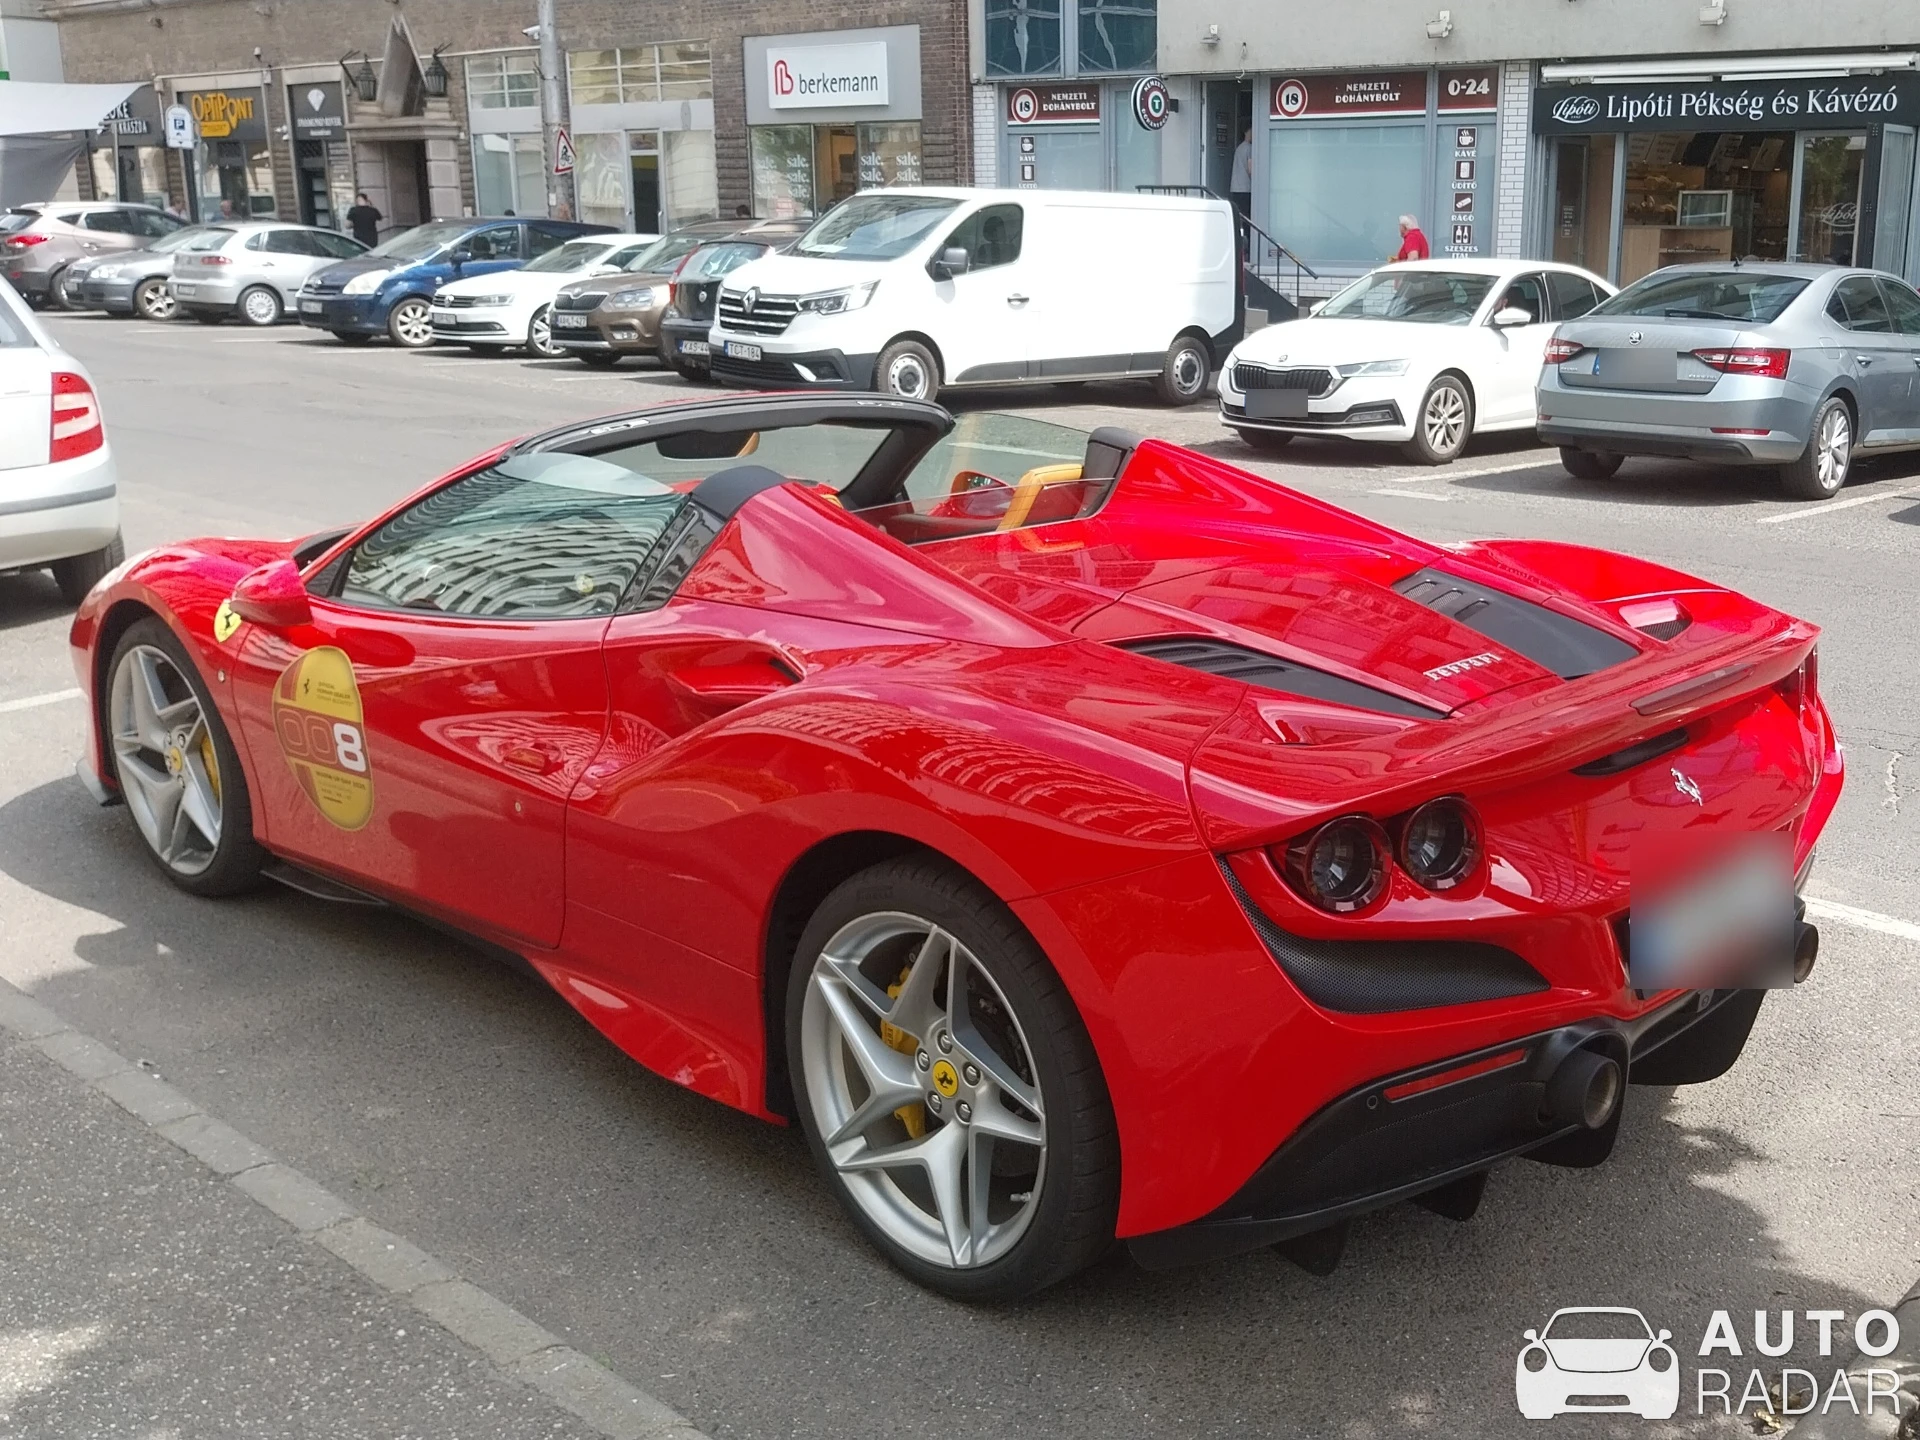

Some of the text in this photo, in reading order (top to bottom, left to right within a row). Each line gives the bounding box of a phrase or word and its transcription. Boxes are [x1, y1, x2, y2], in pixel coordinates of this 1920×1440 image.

[798, 72, 879, 95] berkemann
[1346, 82, 1390, 92] NEMZETI
[1447, 78, 1490, 96] 0-24
[1051, 92, 1088, 101] NEMZETI
[1285, 93, 1299, 106] 18
[1335, 92, 1401, 103] DOHÁNYBOLT
[1606, 84, 1899, 123] Lipóti Pékség és Kávézó
[1019, 101, 1031, 113] 18
[1042, 101, 1097, 112] DOHÁNYBOLT
[1552, 97, 1598, 121] Lipóti
[786, 154, 809, 168] sale.
[861, 151, 921, 166] sale. sale.
[787, 169, 810, 183] sale.
[861, 167, 921, 182] sale. sale.
[1444, 245, 1479, 253] SZESZES
[1422, 652, 1502, 682] Ferrari
[276, 708, 367, 773] 008
